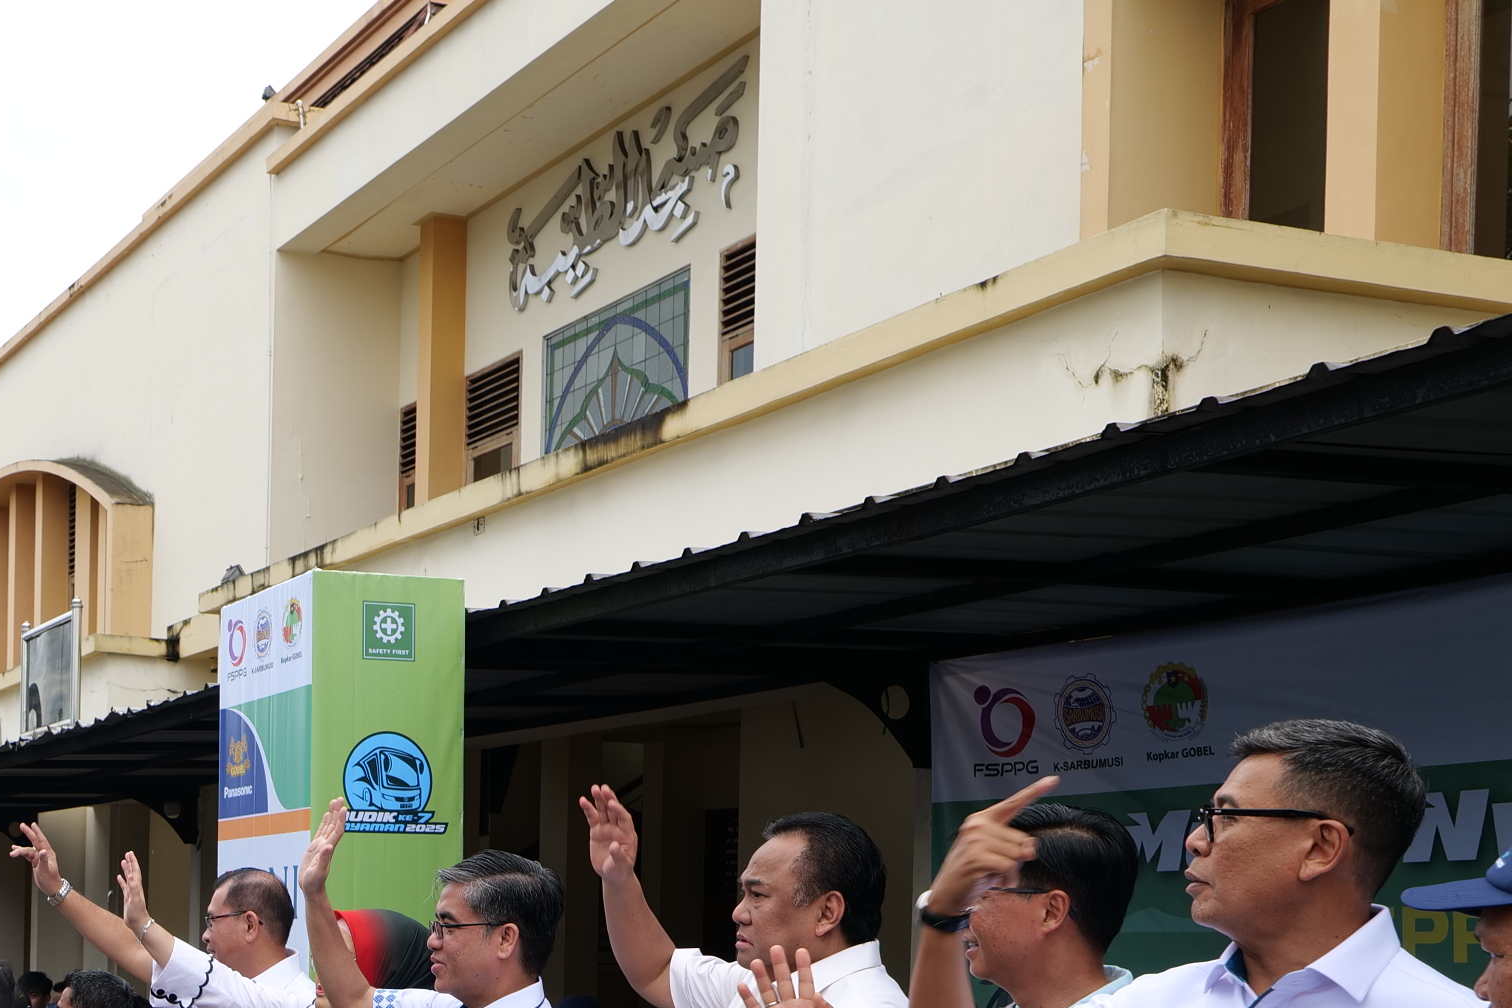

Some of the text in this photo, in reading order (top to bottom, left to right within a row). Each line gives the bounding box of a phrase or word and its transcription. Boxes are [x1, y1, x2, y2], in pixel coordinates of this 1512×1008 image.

[227, 667, 248, 682] FSPPG
[1146, 745, 1215, 763] Kopkar GOBEL
[230, 765, 245, 776] GOBEL
[974, 760, 1039, 778] FSPPG
[1053, 757, 1124, 773] K-SARBUMUSI
[224, 785, 253, 798] Panasonic
[405, 824, 446, 832] 2025
